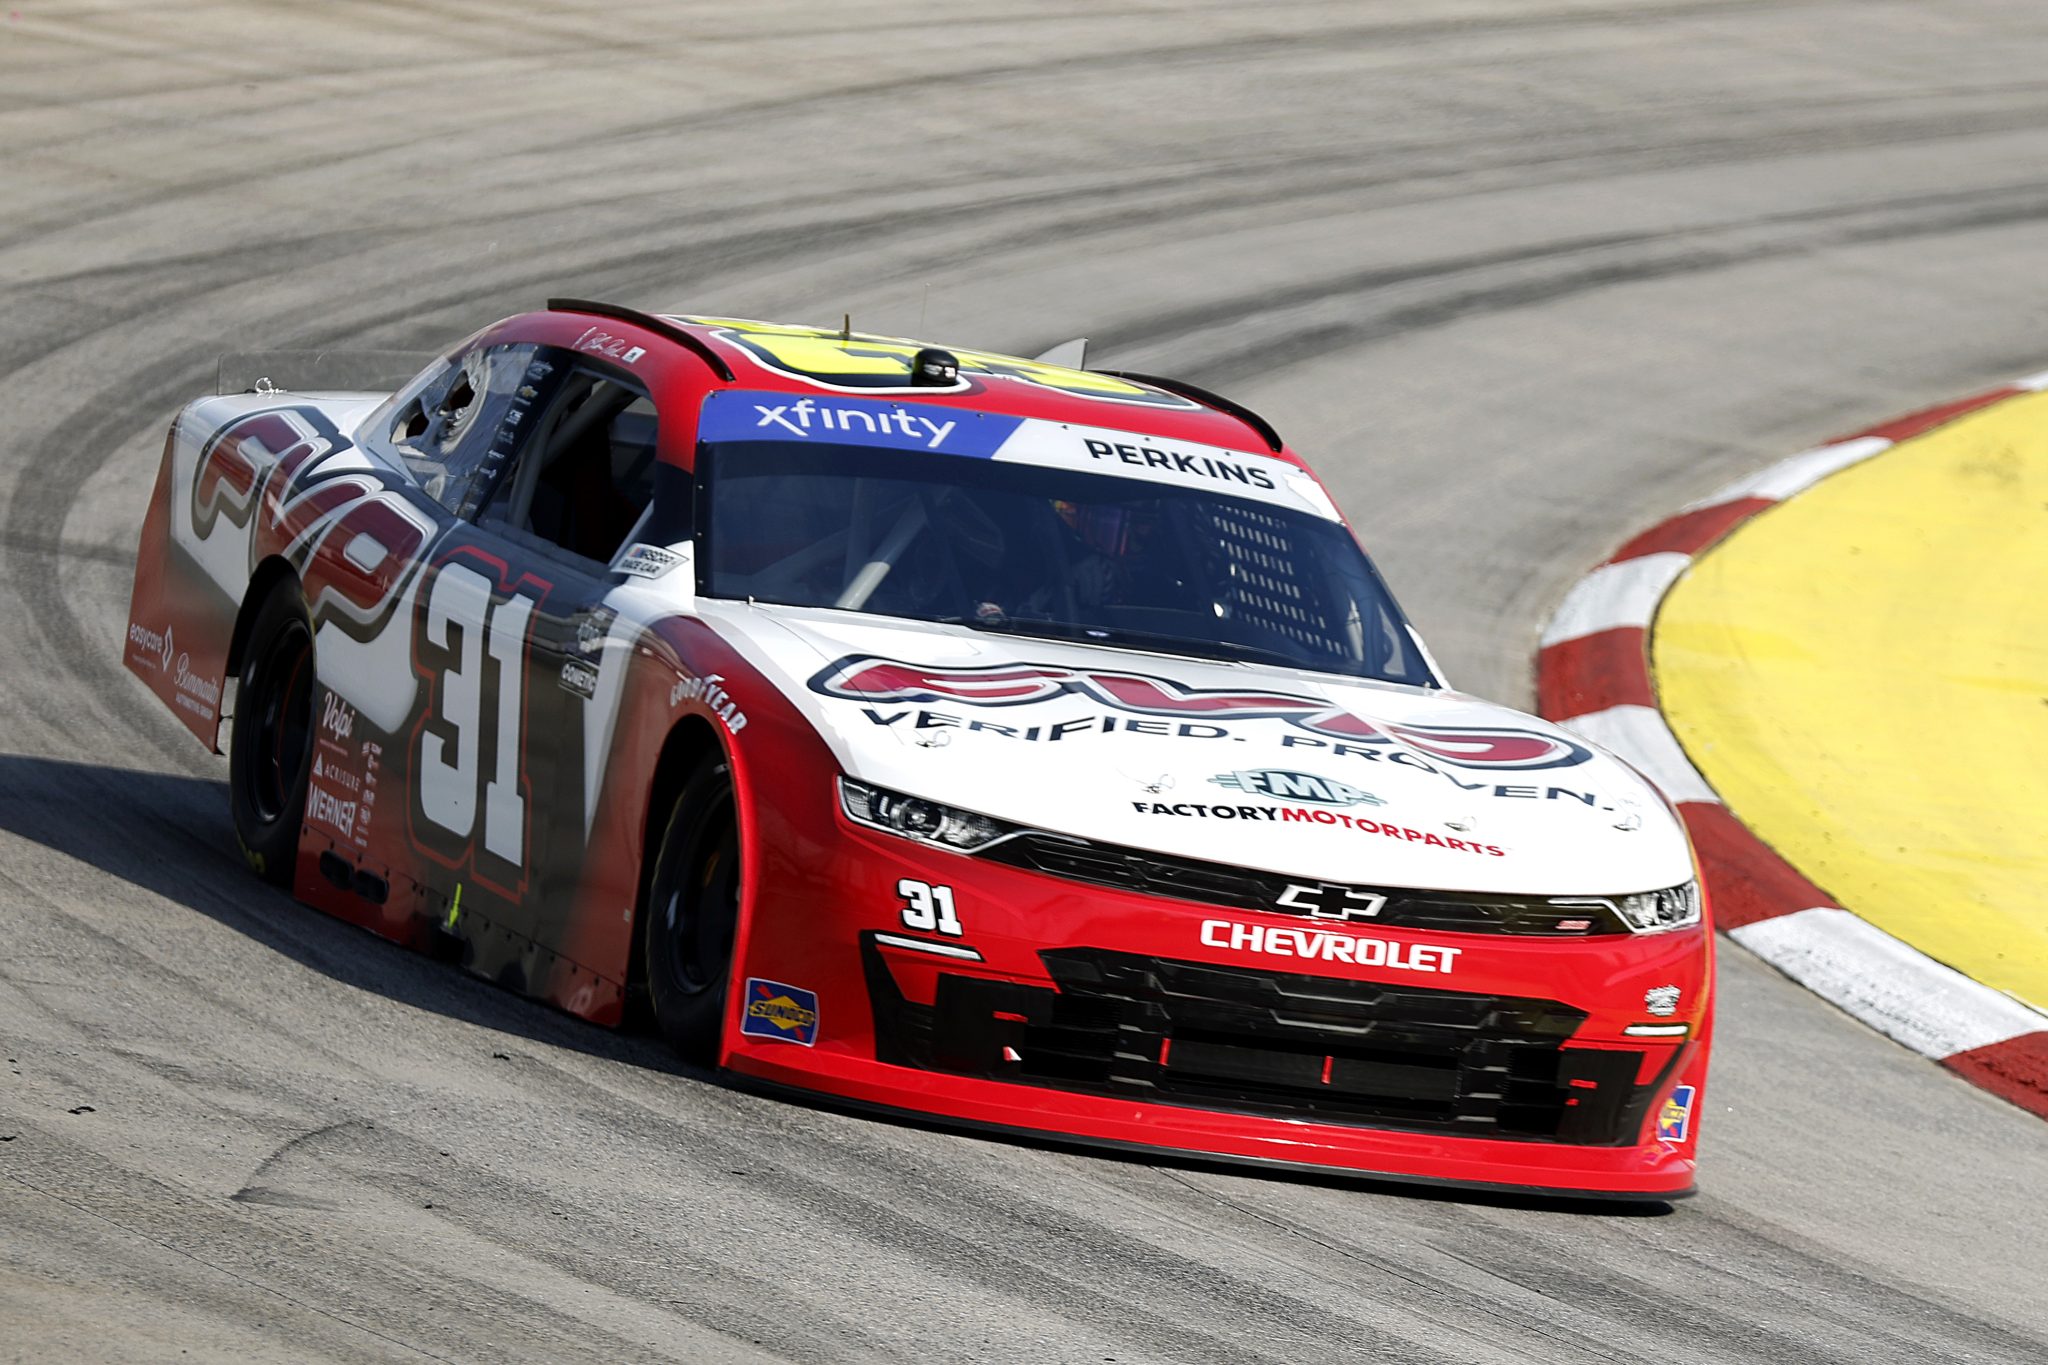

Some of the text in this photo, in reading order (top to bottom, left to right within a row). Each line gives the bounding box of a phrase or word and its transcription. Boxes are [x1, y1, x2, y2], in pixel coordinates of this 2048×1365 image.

[754, 399, 956, 449] xfinity
[1085, 438, 1275, 490] PERKINS
[640, 562, 660, 574] CAR
[130, 623, 162, 653] easycare
[562, 663, 597, 691] COMETIC
[322, 691, 355, 740] Volpi
[419, 561, 534, 867] 31
[324, 763, 360, 791] ACRISURE
[861, 708, 1615, 811] VERIFIED. PROVEN.
[307, 781, 356, 838] WERNER
[1234, 769, 1365, 804] FMP
[898, 878, 964, 937] 31
[1200, 920, 1462, 974] CHEVROLET
[748, 1000, 816, 1027] SUNOCO
